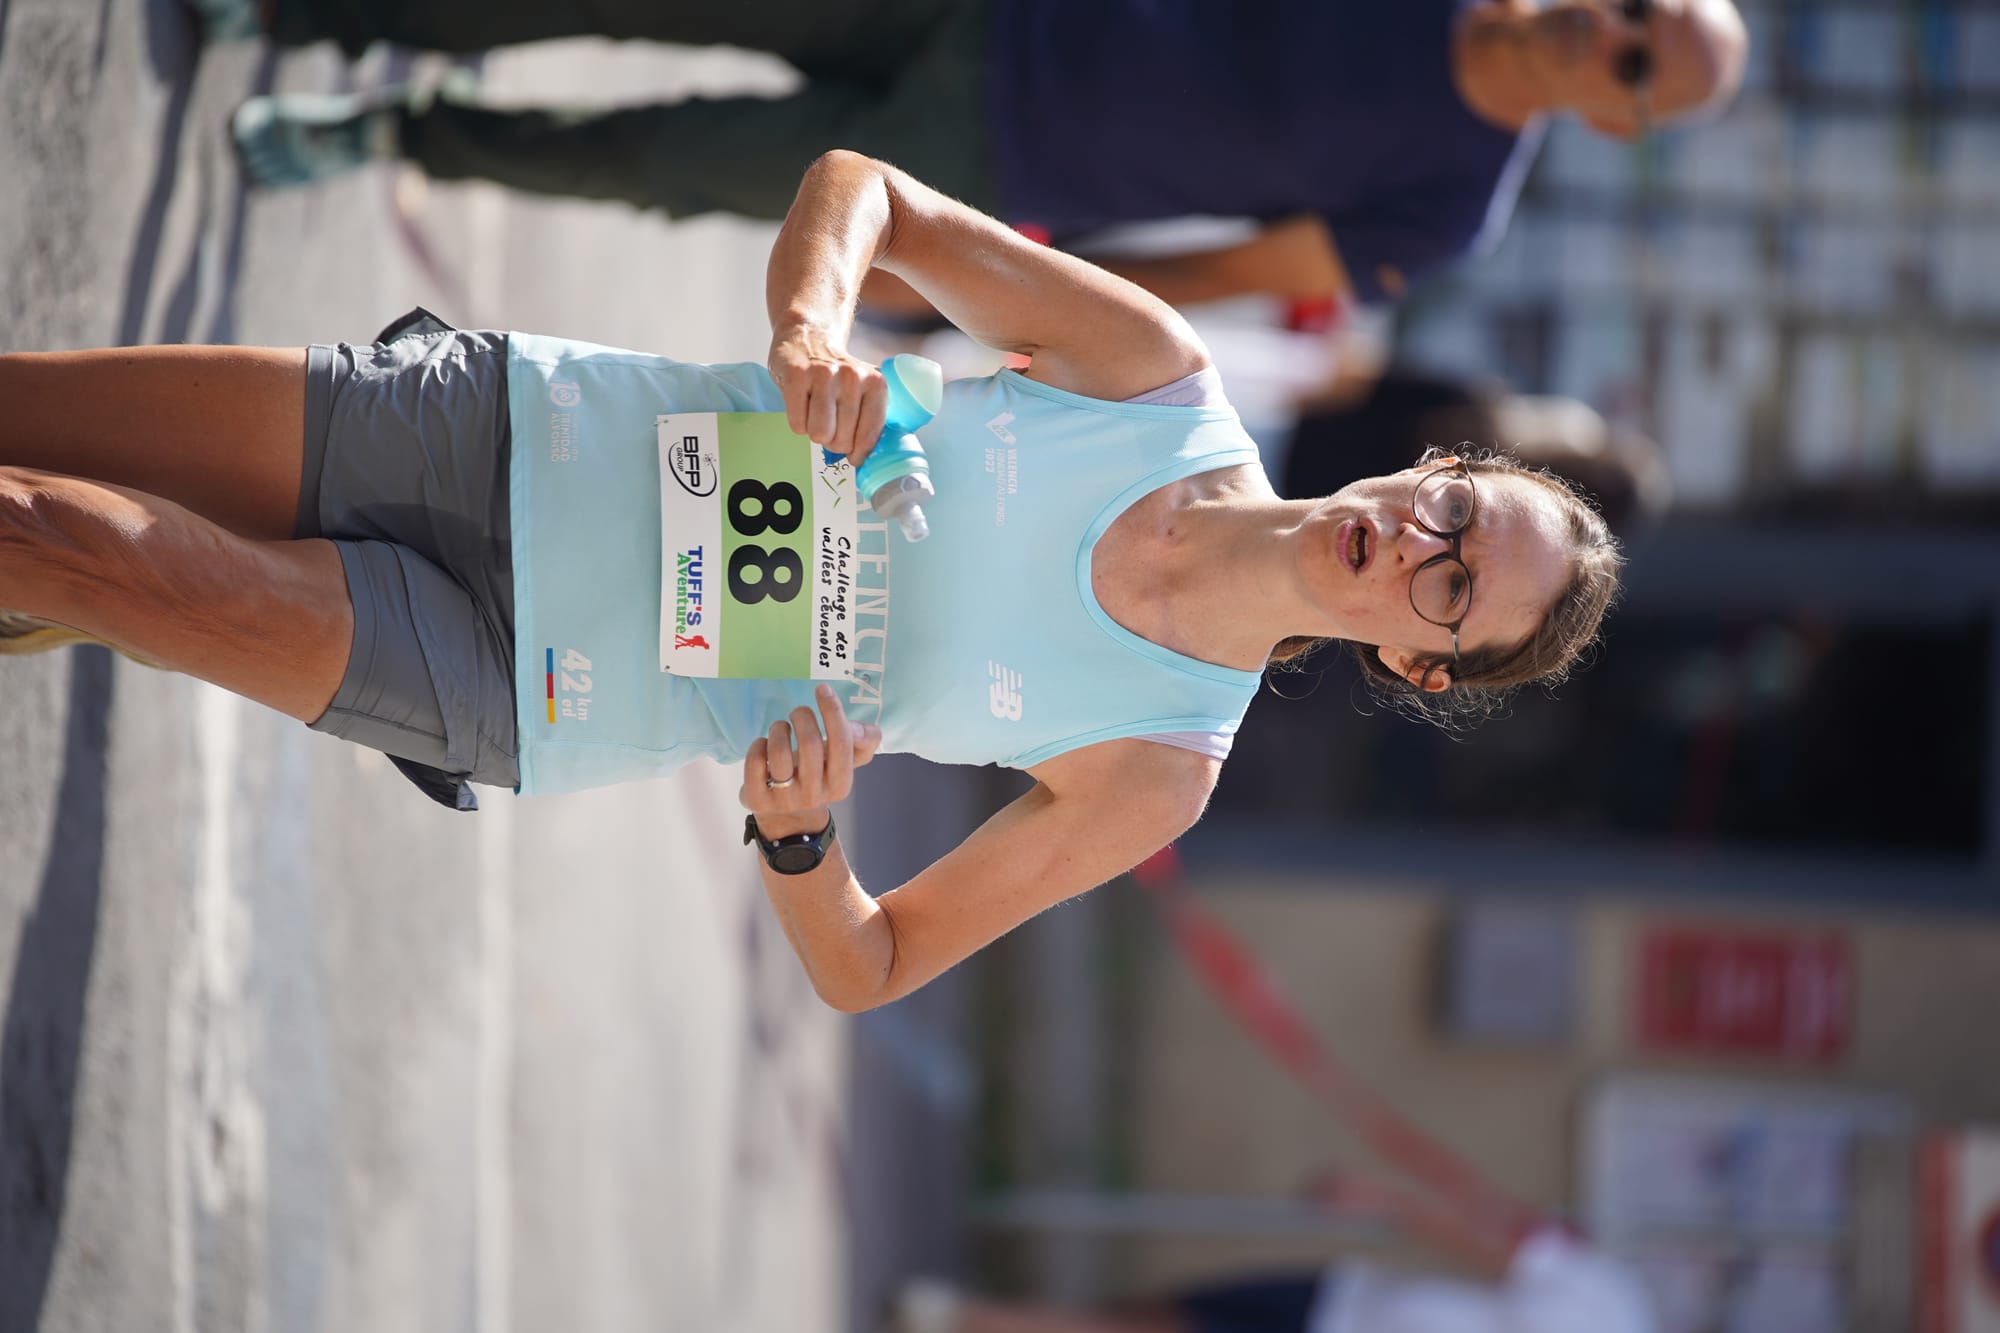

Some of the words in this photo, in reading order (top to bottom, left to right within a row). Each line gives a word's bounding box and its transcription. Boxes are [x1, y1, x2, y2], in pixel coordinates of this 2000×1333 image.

[676, 448, 684, 472] GROUP
[683, 436, 701, 487] BFP
[984, 448, 995, 473] 2022
[1007, 448, 1017, 495] VALENCIA
[727, 478, 804, 605] 88
[821, 527, 835, 586] vallées
[675, 552, 693, 634] Aventure
[686, 545, 703, 626] TUFF'S
[832, 536, 851, 622] Challenge
[849, 492, 889, 704] LENCIA
[819, 595, 835, 668] cévenoles
[835, 631, 849, 660] des
[560, 648, 593, 694] 42
[561, 698, 577, 717] ed
[577, 698, 593, 721] km
